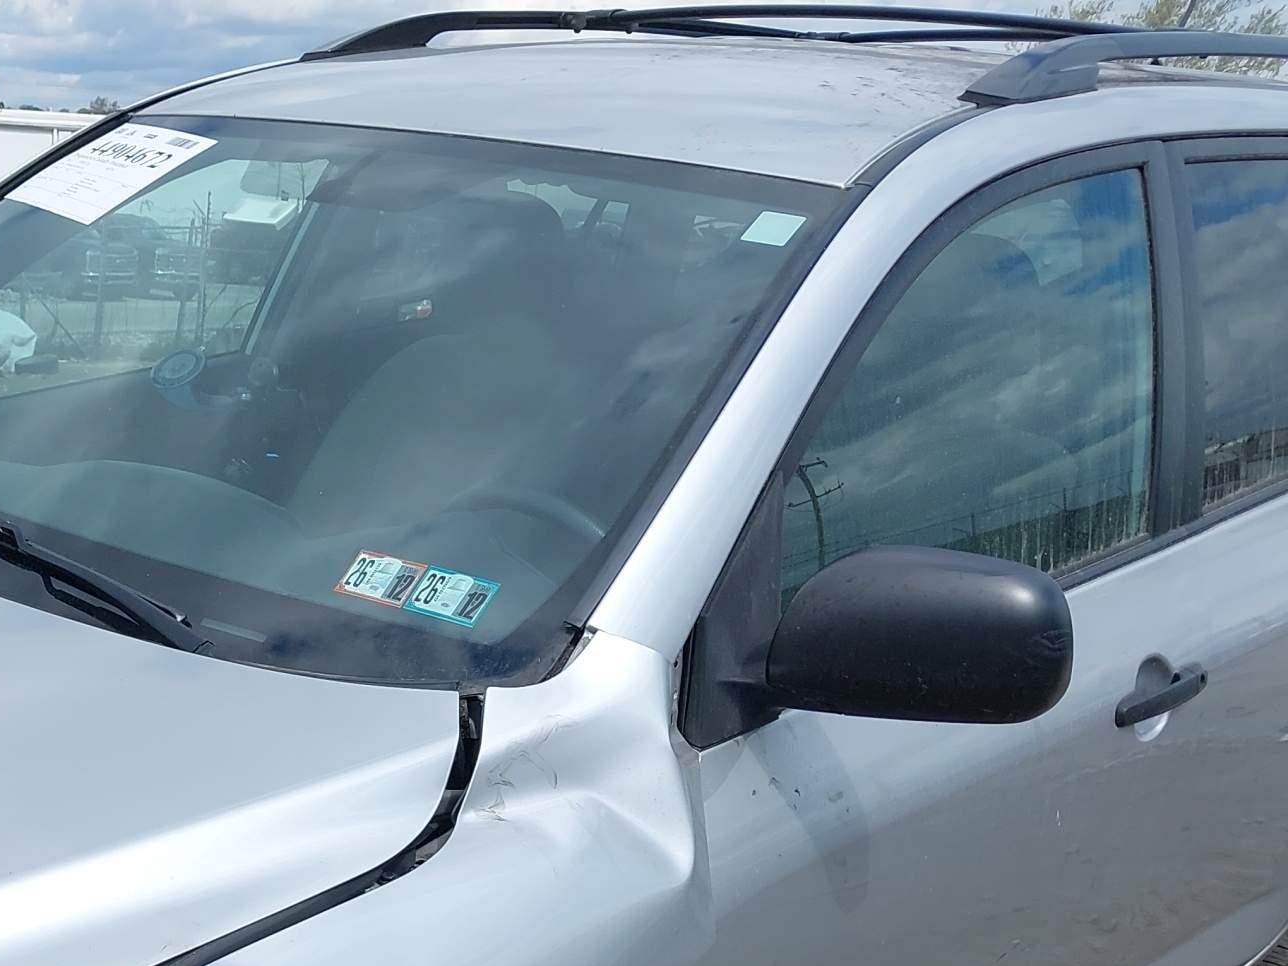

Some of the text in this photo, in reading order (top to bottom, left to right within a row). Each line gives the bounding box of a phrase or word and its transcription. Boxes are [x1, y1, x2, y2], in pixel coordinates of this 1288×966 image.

[90, 140, 173, 168] 44904672
[344, 557, 375, 588] 26
[387, 573, 416, 601] 12
[414, 573, 446, 604] 26
[458, 591, 488, 619] 12
